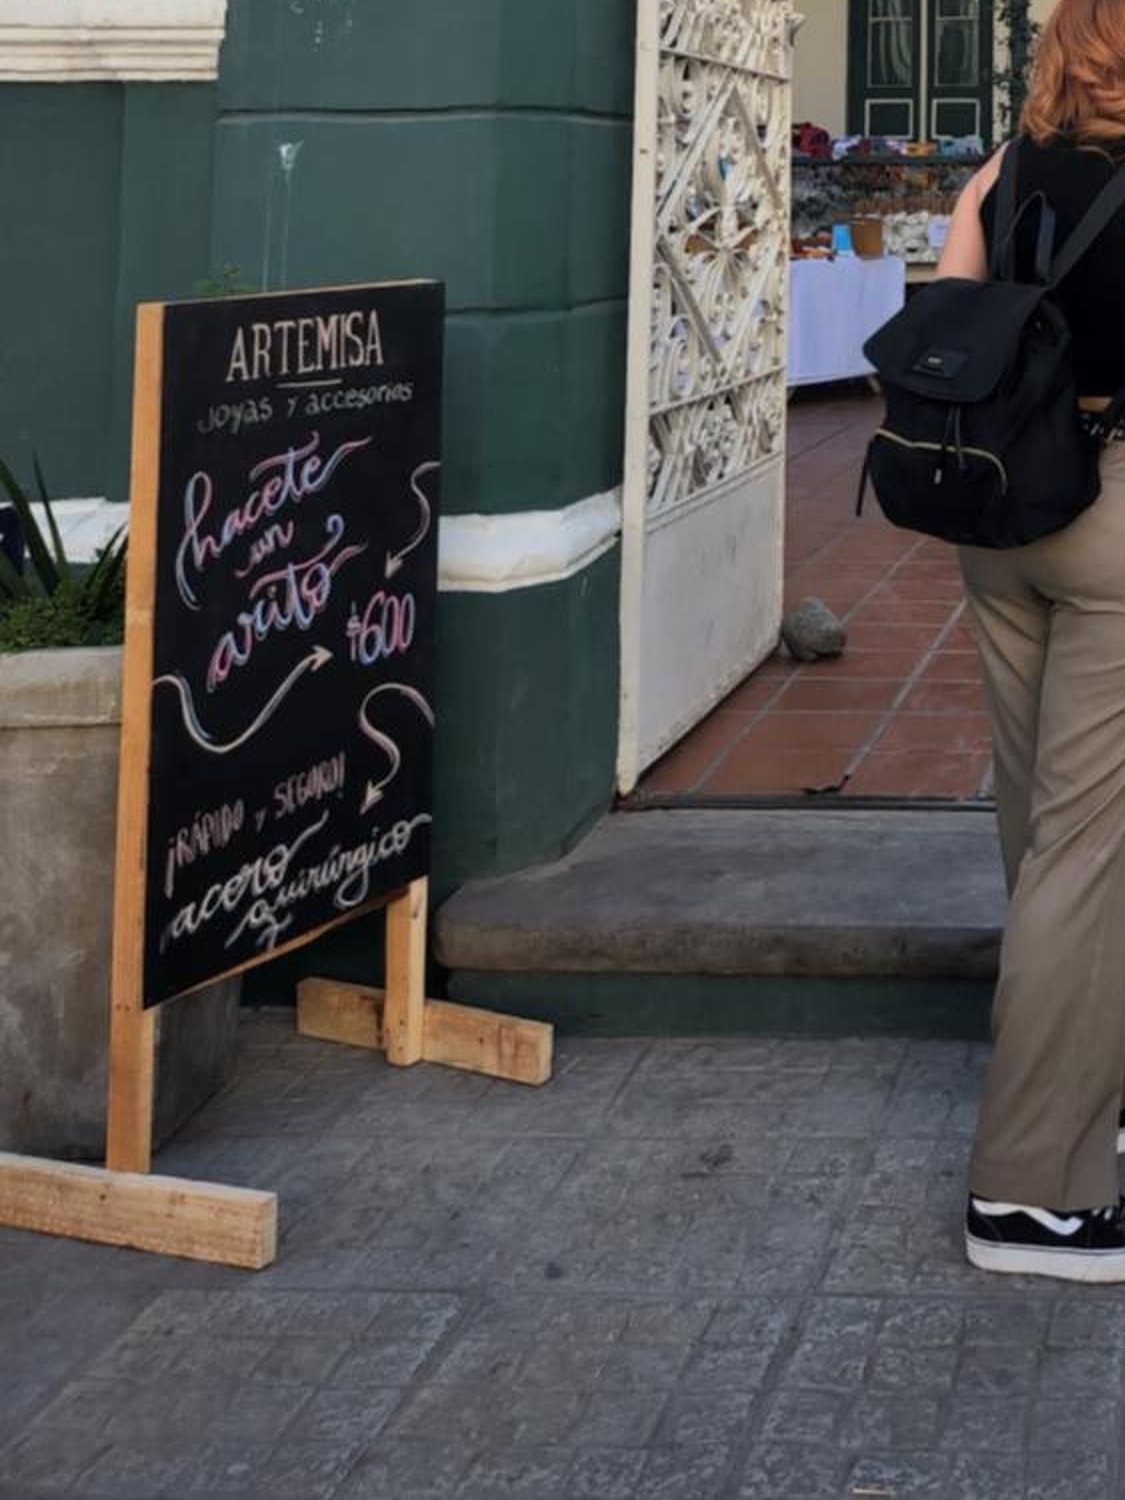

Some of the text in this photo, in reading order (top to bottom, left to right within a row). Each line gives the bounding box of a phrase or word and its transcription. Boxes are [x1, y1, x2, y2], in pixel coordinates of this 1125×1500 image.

[225, 310, 385, 383] ARTEMISA
[305, 382, 414, 417] accesorios
[176, 430, 373, 611] hacete
[235, 520, 295, 578] un
[346, 590, 417, 665] $600
[158, 809, 330, 951] acero
